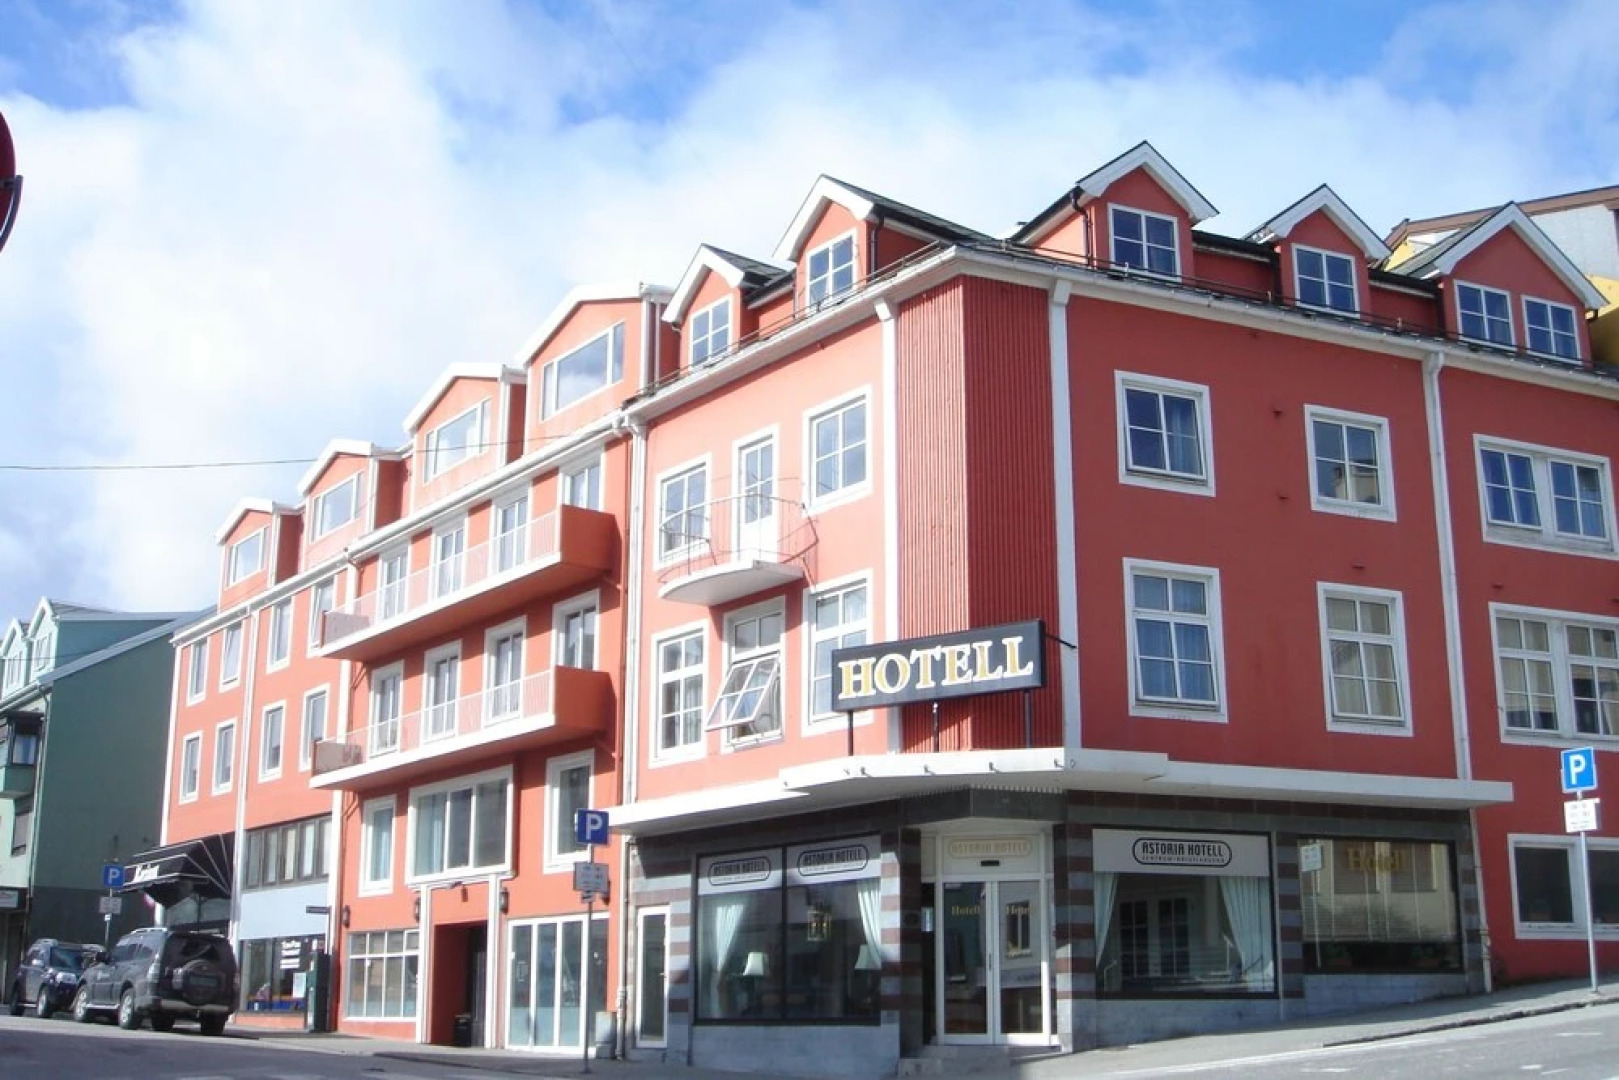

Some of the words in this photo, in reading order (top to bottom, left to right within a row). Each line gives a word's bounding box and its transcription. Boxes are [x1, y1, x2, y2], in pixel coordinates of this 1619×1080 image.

[838, 636, 1033, 699] HOTELL
[1569, 754, 1586, 785] P
[585, 813, 603, 840] P
[1142, 841, 1184, 855] ASTORIA
[1187, 844, 1223, 857] HOTELL
[108, 868, 120, 885] P
